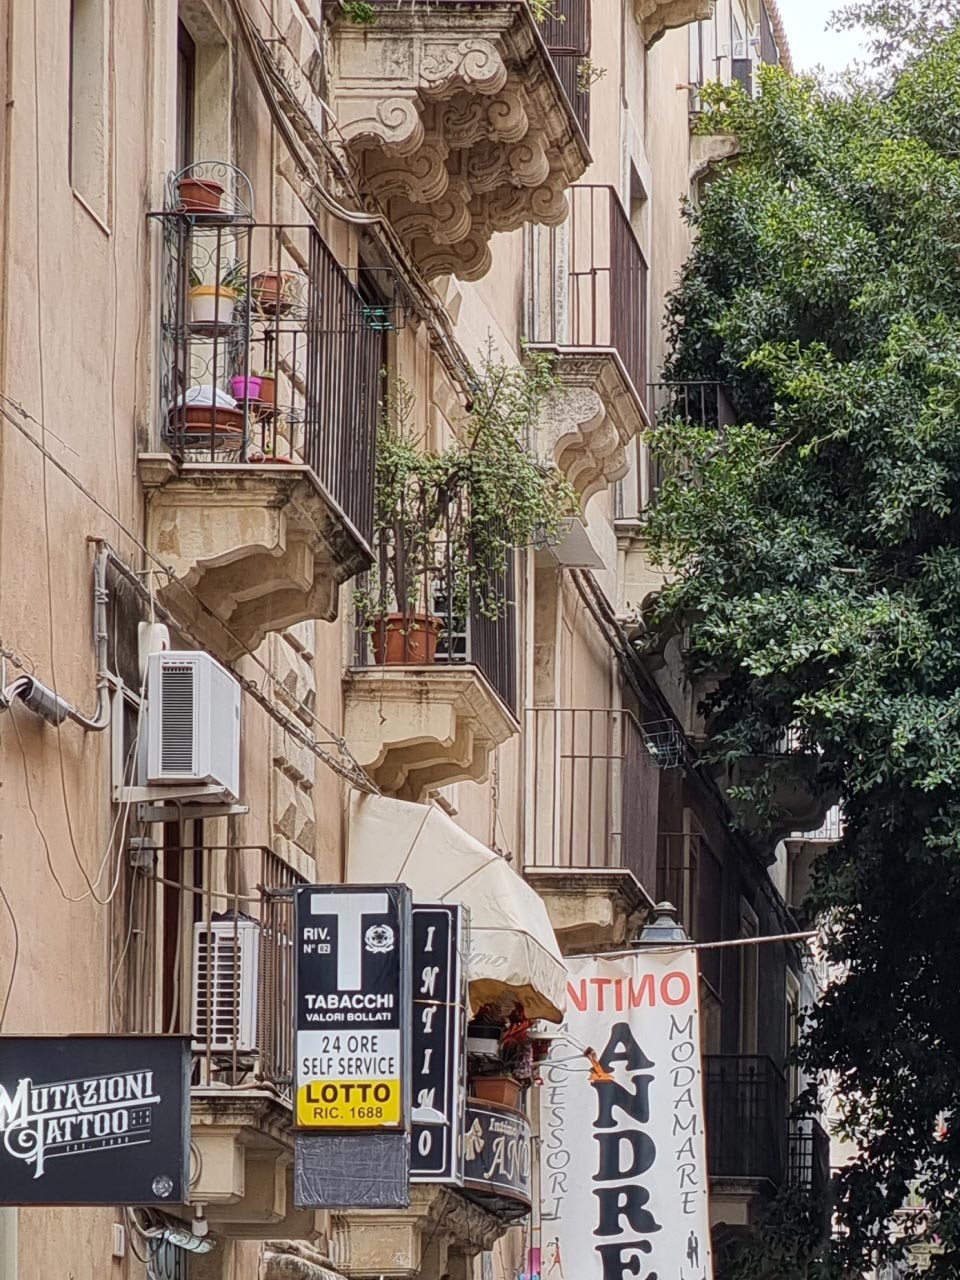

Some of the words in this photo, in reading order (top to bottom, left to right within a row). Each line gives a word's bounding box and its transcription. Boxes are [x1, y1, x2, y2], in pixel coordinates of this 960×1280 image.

[303, 928, 331, 940] RIV.
[566, 971, 691, 1012] NTIMO
[304, 994, 394, 1009] TABACCHI
[306, 1013, 345, 1022] VALORI
[346, 1012, 392, 1021] BOLLATI
[322, 1035, 341, 1053] 24
[347, 1035, 379, 1053] ORE
[303, 1058, 334, 1075] SELF
[338, 1056, 395, 1074] SERVICE
[0, 1071, 160, 1130] MUTAZIONI
[306, 1084, 391, 1104] LOTTO
[313, 1107, 344, 1119] RIC.
[350, 1107, 383, 1118] 1688
[669, 1014, 700, 1214] MODAMARE
[4, 1108, 129, 1178] TATTOO
